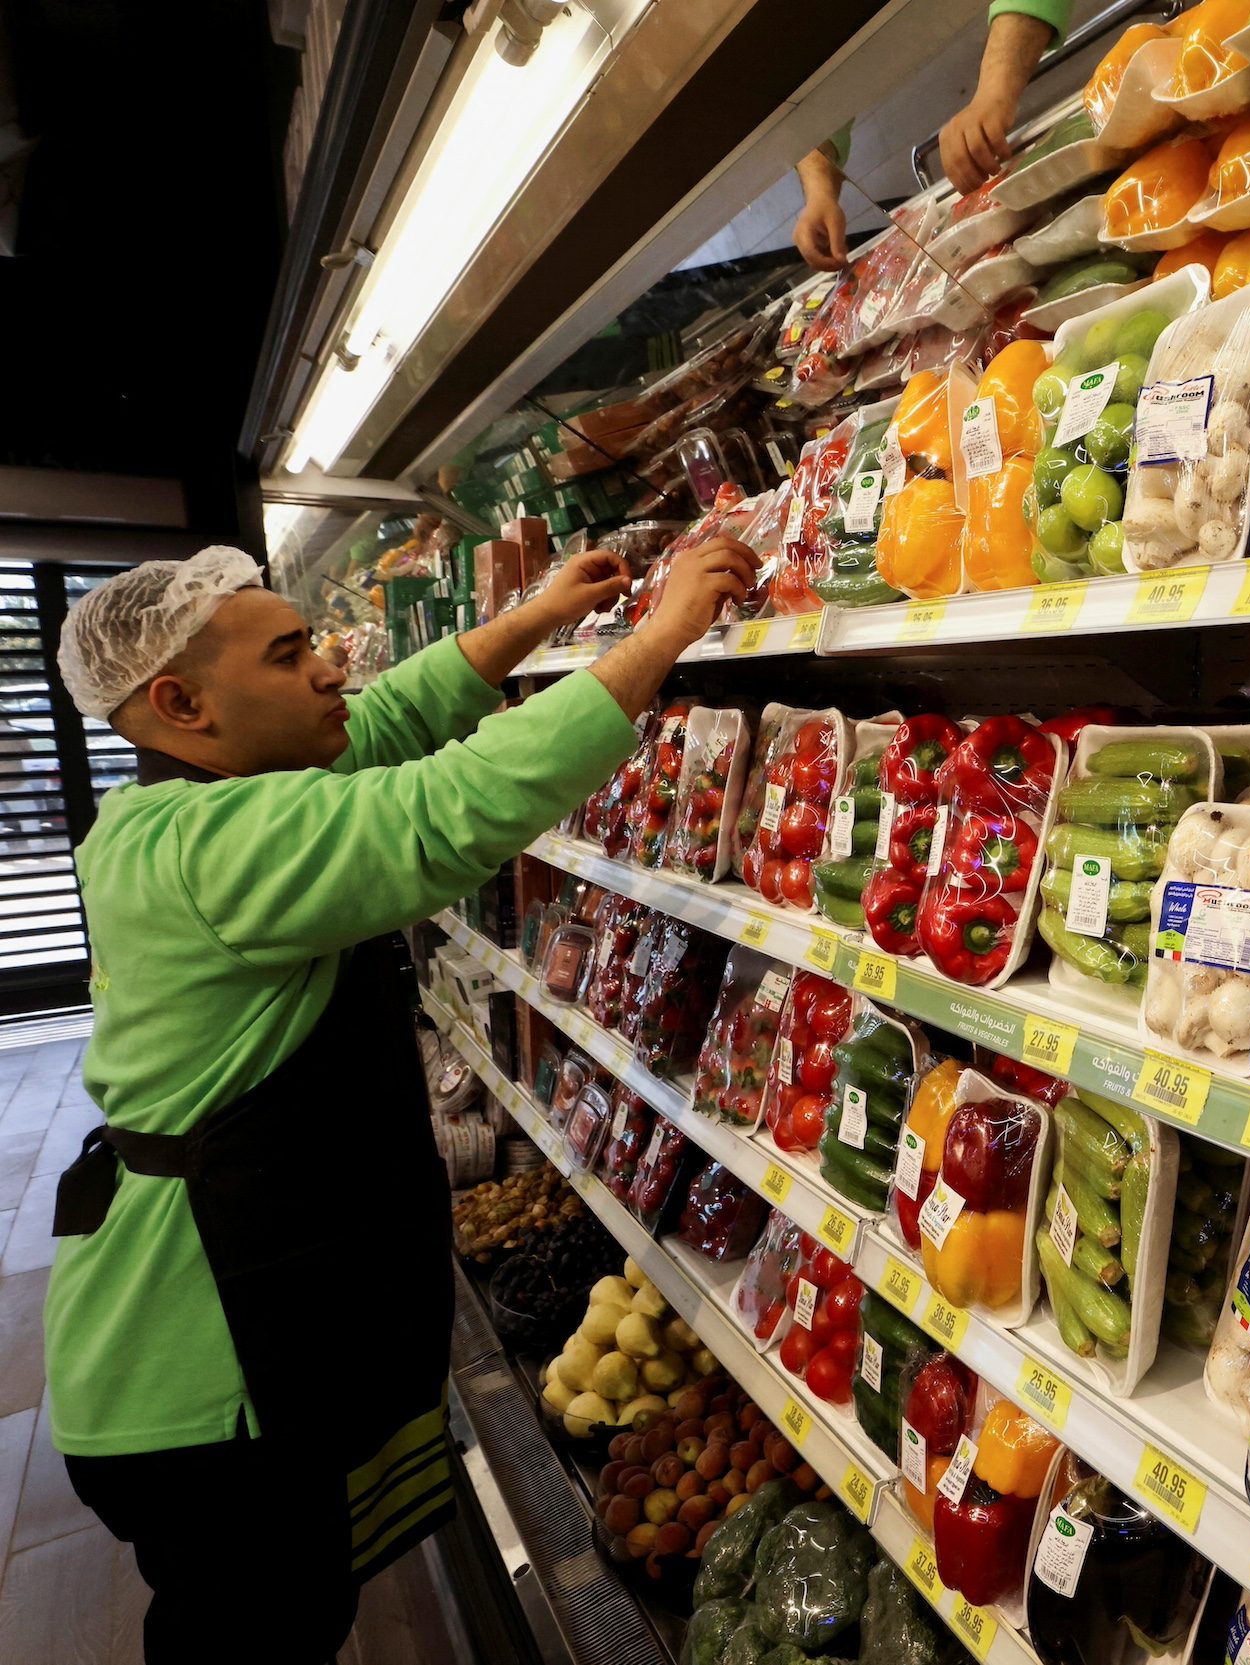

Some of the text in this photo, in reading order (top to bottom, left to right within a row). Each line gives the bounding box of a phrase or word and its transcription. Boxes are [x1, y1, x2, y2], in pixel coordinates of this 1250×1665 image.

[1148, 584, 1186, 604] 40.95
[1168, 901, 1187, 913] Whole
[863, 962, 885, 981] 35.95
[949, 1002, 1017, 1036] الخضروات والفواكه
[957, 1021, 1010, 1048] FRUITS & VEGETABLES
[1029, 1029, 1061, 1052] 27.95
[1092, 1056, 1131, 1081] والفواكه
[1153, 1066, 1190, 1096] 40.95
[1103, 1079, 1131, 1097] FRUITS &
[772, 1169, 786, 1187] 18.95
[827, 1212, 846, 1235] 26.95
[890, 1268, 911, 1294] 37.95
[933, 1303, 957, 1330] 36.95
[1029, 1369, 1058, 1400] 25.95
[790, 1403, 805, 1429] 18.95
[850, 1472, 869, 1498] 24.95
[1152, 1461, 1188, 1499] 40.95
[1055, 1518, 1075, 1536] MAFA
[917, 1551, 937, 1579] 37.95
[960, 1602, 984, 1633] 36.95
